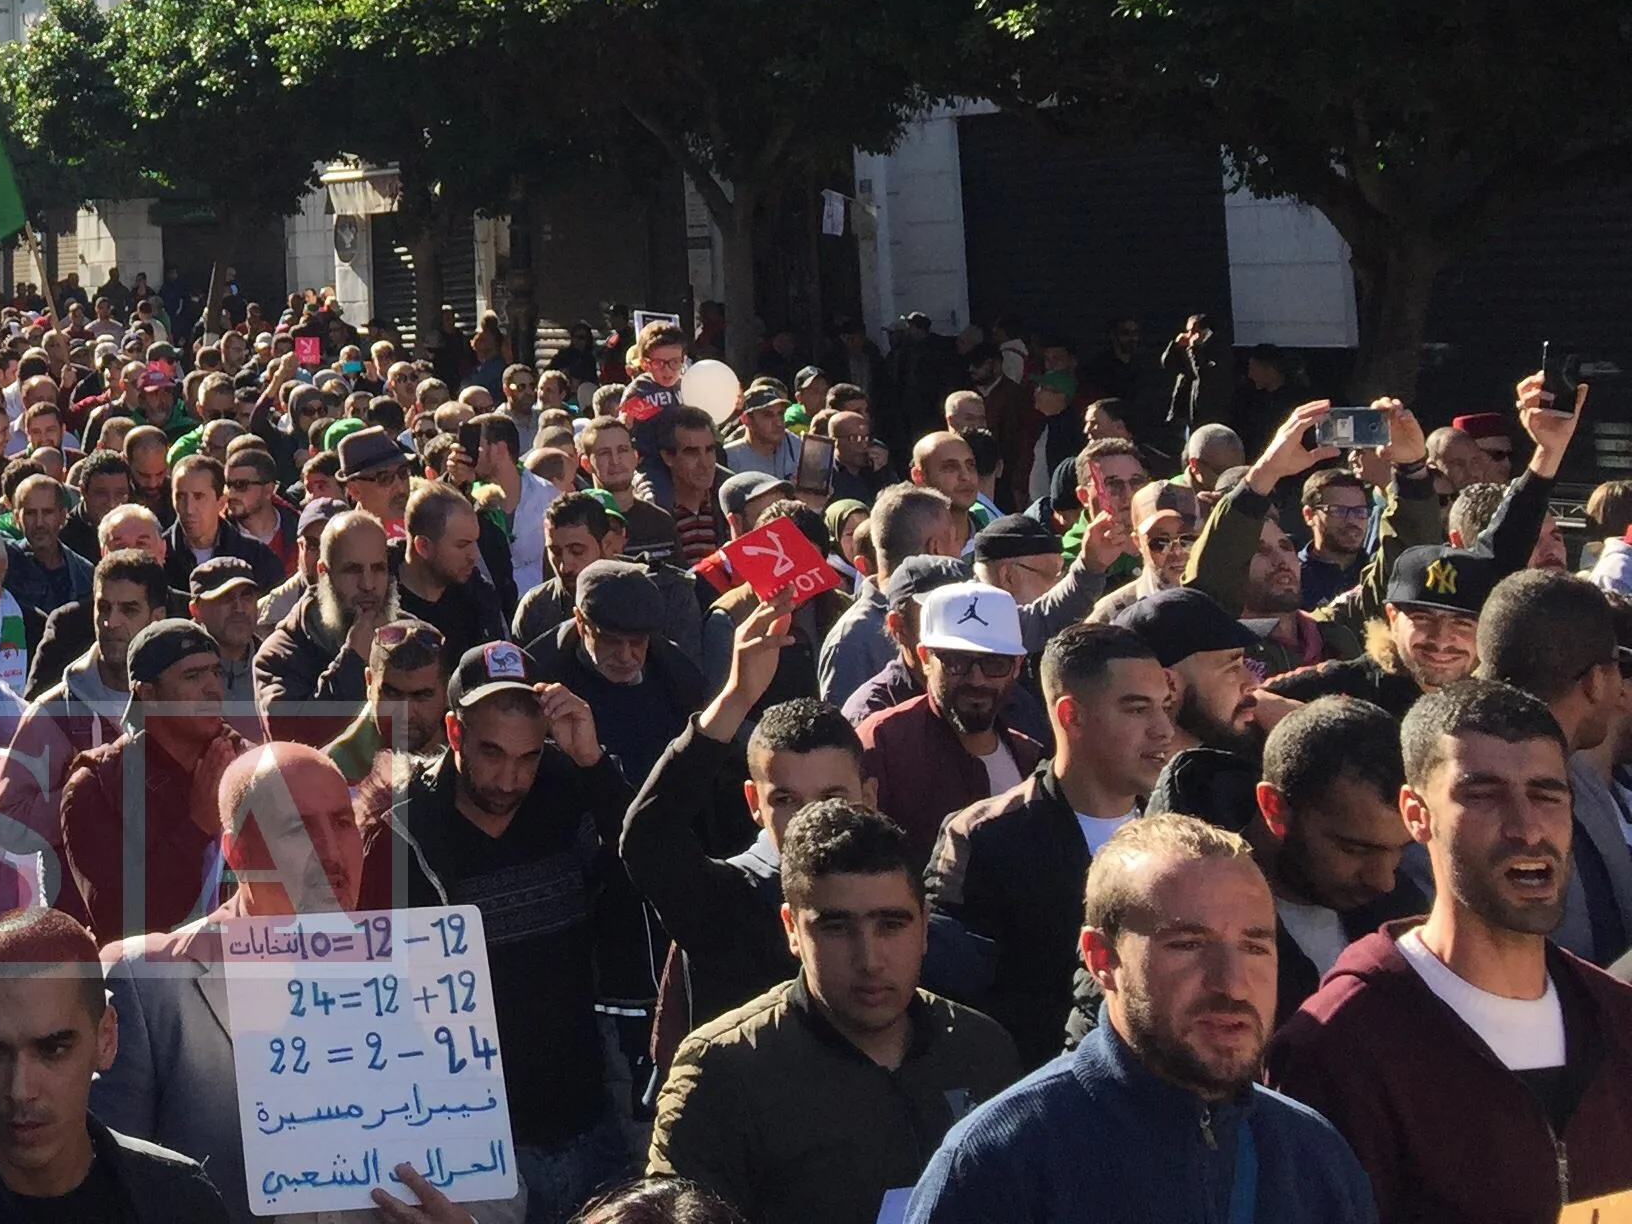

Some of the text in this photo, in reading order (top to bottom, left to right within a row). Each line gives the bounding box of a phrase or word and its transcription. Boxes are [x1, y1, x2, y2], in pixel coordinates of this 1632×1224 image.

[742, 529, 795, 577] لا
[269, 1036, 311, 1075] 22
[256, 1101, 365, 1134] مسيرة
[262, 1147, 381, 1205] الشعبي
